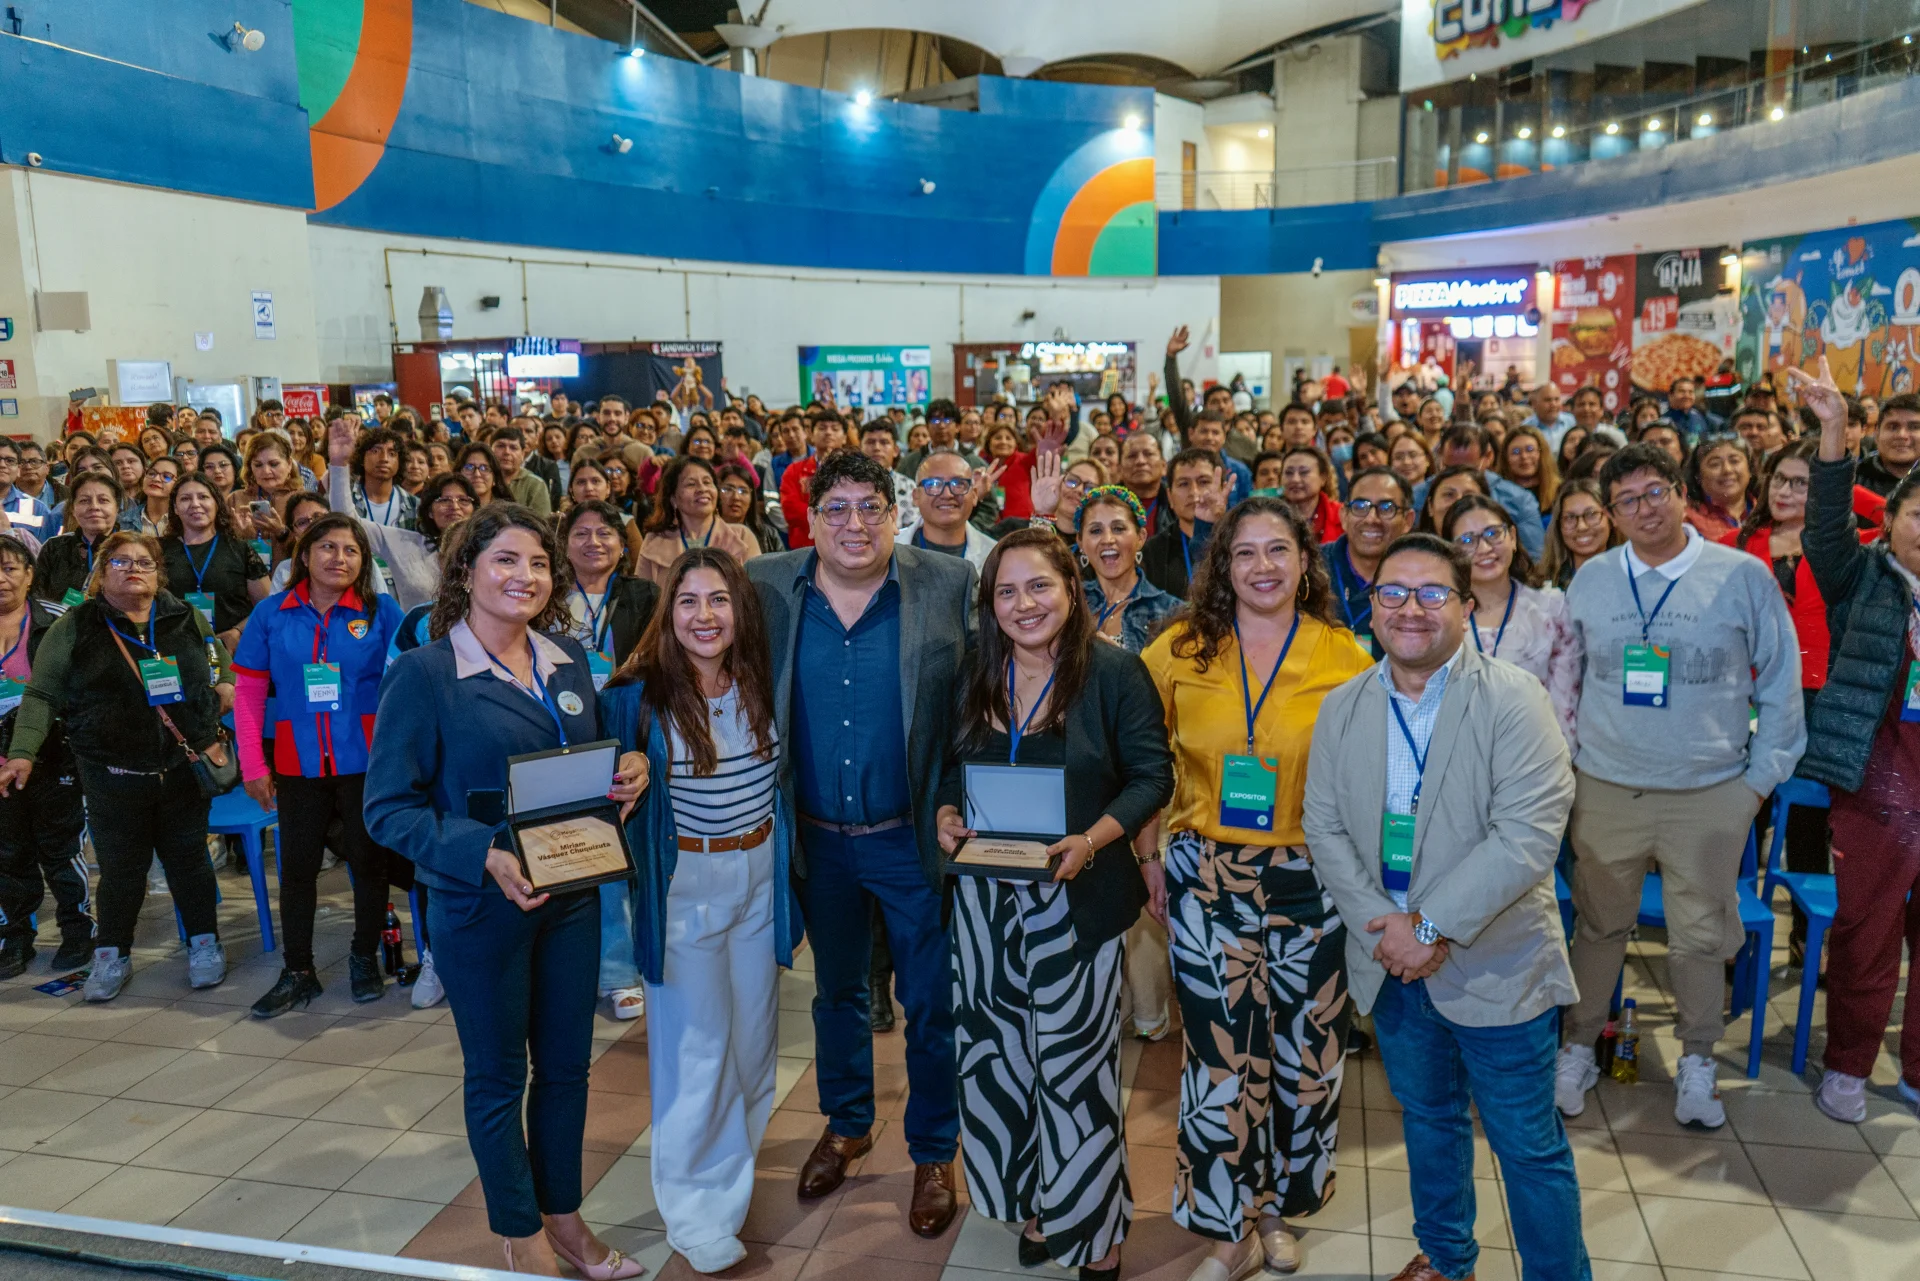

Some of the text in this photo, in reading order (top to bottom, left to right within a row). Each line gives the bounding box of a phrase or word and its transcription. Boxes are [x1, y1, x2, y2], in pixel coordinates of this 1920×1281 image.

[1612, 611, 1698, 623] NEW OLEANS
[313, 689, 336, 698] YENNY
[1229, 792, 1267, 801] EXPOSITOR
[560, 841, 586, 851] Miriam
[537, 850, 569, 861] Vásquez
[570, 842, 611, 855] Chuquizuta
[1391, 853, 1412, 862] EXPO
